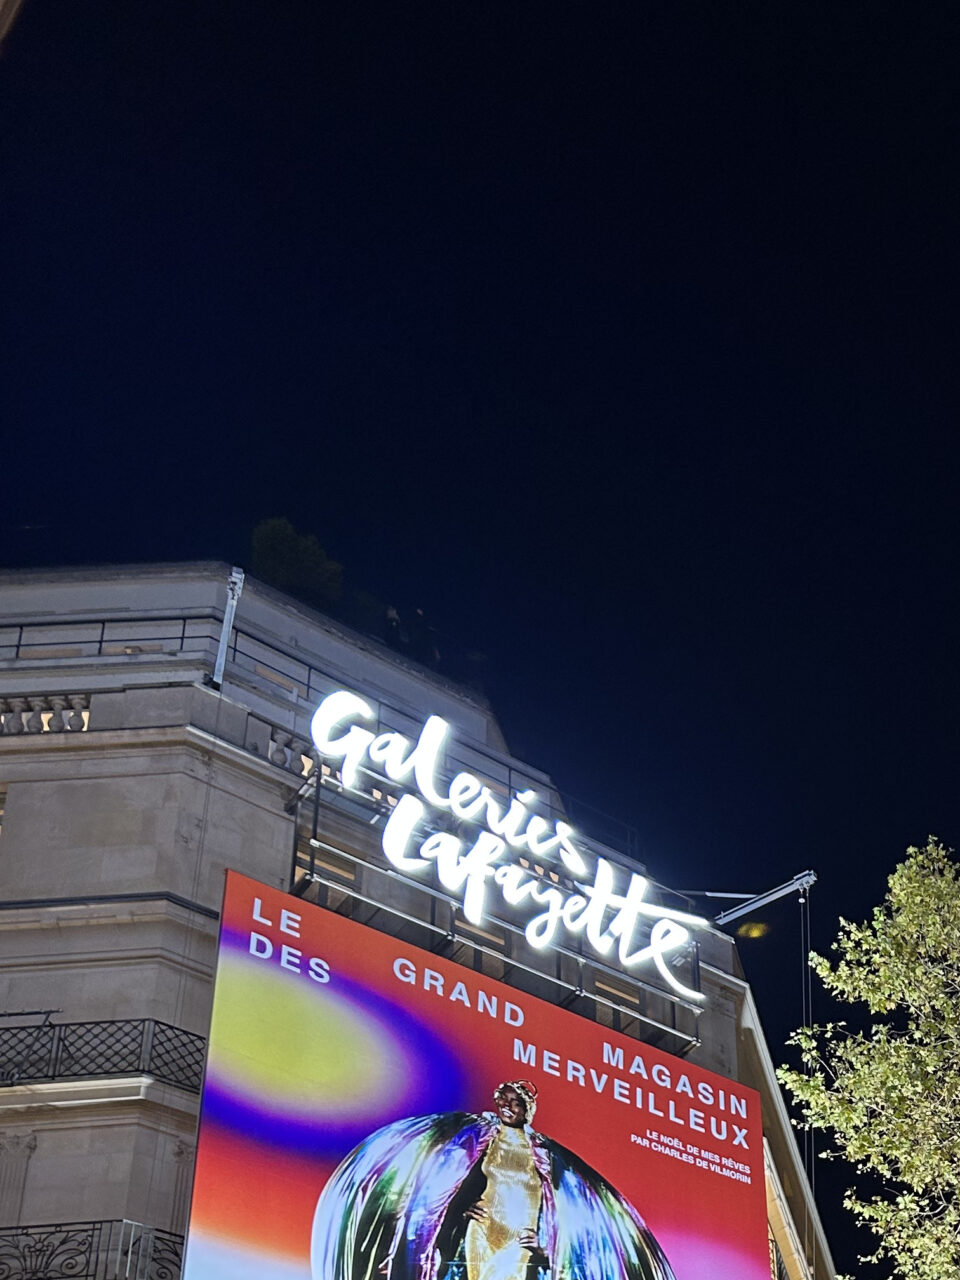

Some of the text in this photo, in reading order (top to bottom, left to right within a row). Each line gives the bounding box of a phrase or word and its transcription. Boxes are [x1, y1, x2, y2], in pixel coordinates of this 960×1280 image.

[310, 690, 588, 875] Galeries
[381, 793, 709, 999] Lafayette
[249, 931, 749, 1149] DES MERVEILLEUX
[252, 897, 747, 1119] LE GRAND MAGASIN
[631, 1134, 751, 1184] PAR CHARLES DE VILMORIN
[646, 1129, 751, 1174] LE NOËL DE MES RÊVES
